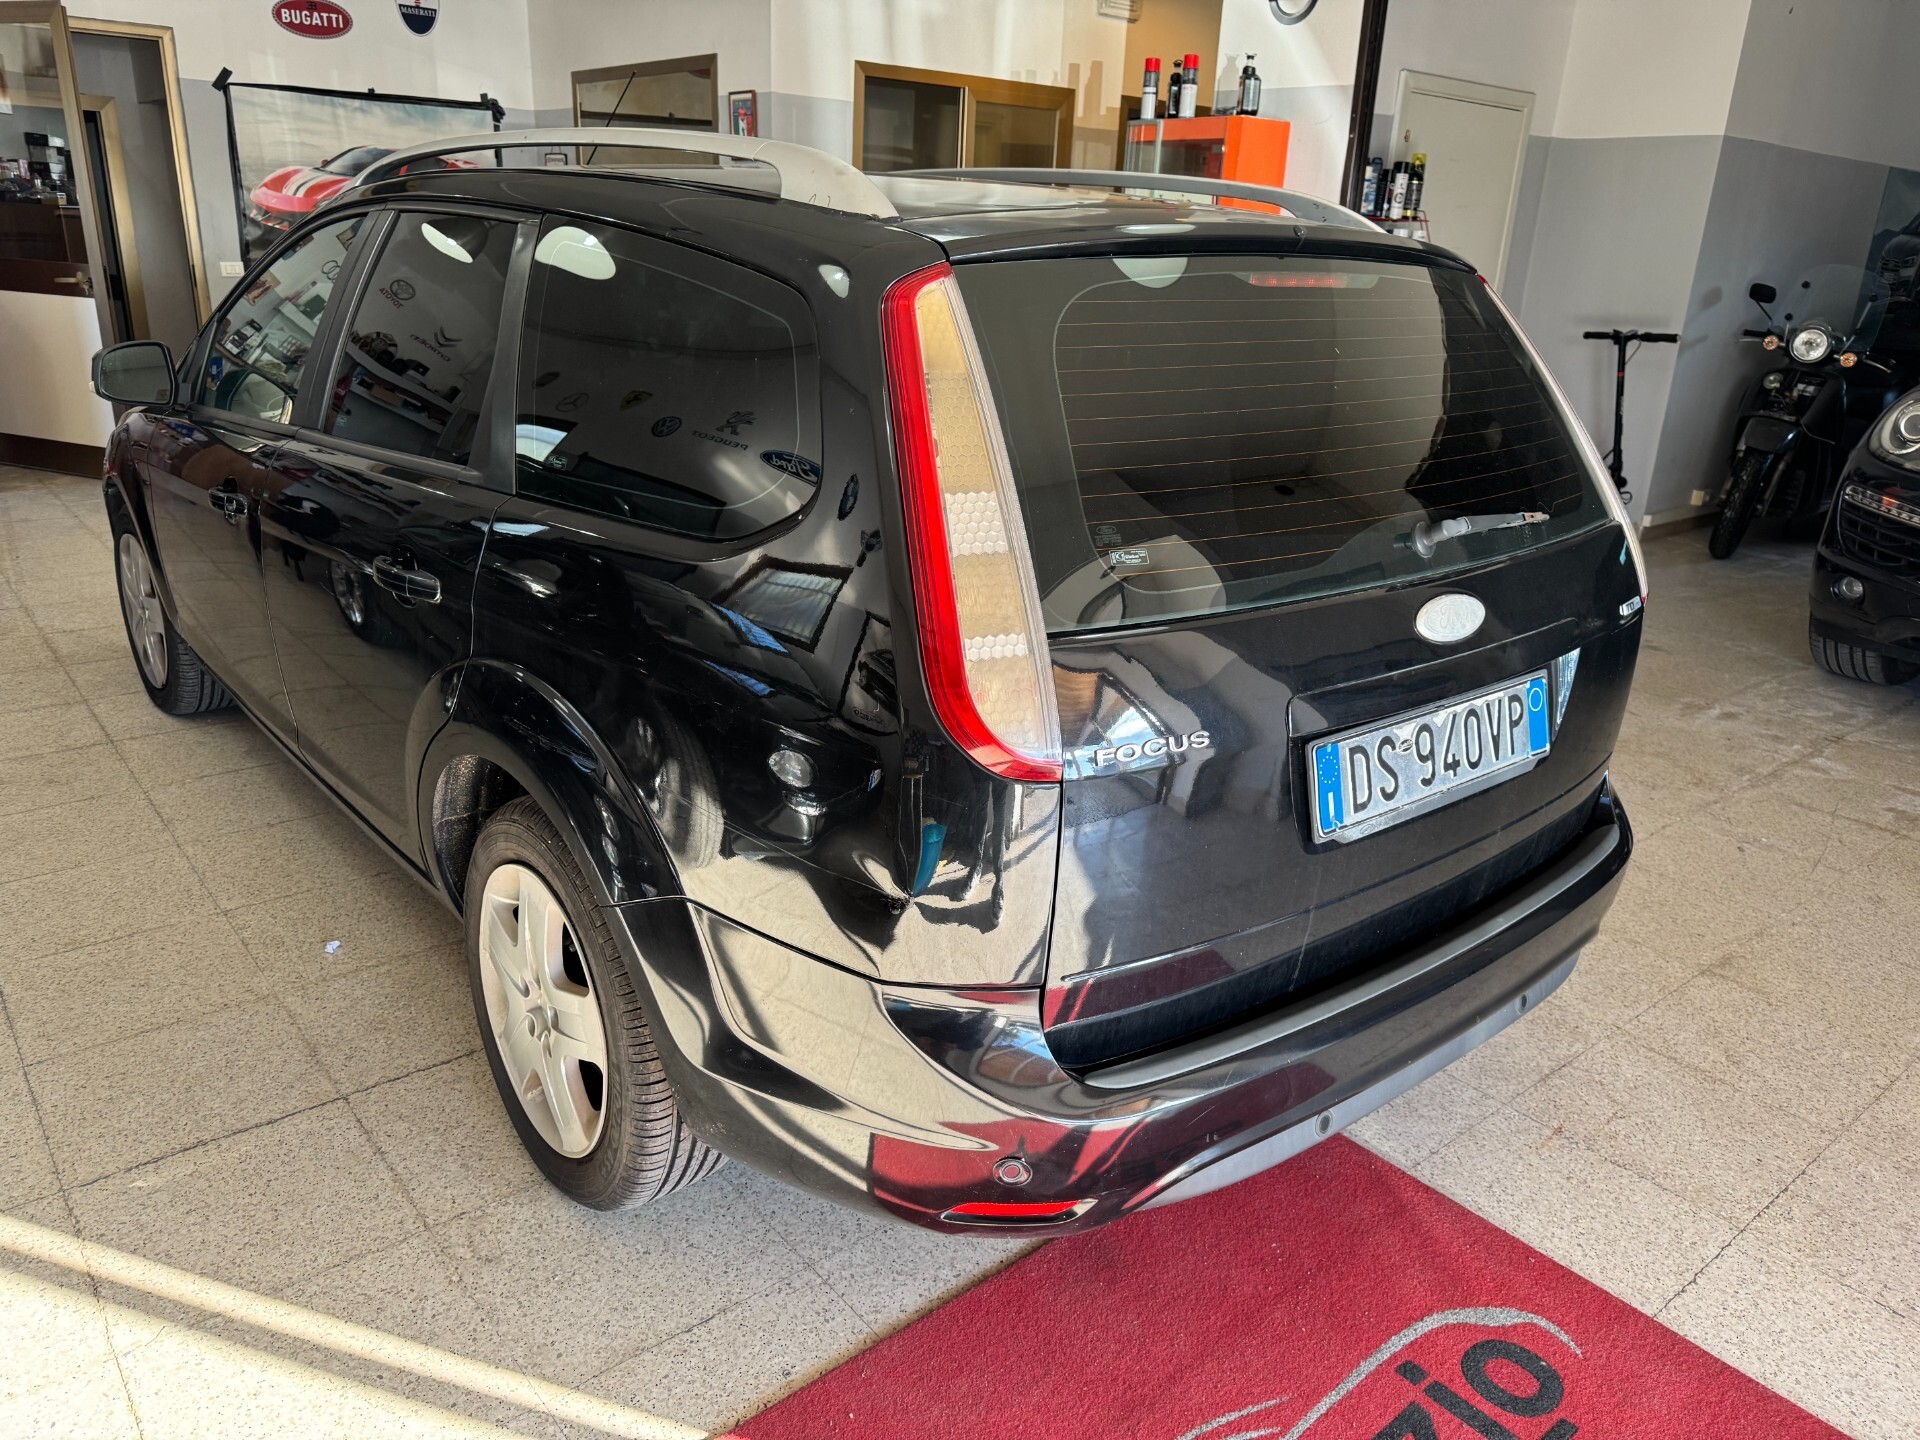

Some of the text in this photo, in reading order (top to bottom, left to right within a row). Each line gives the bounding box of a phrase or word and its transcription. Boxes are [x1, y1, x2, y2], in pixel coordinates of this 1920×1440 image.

[280, 8, 344, 29] BUGATTI
[400, 5, 436, 18] MASERATI
[1094, 730, 1211, 767] FOCUS
[1345, 735, 1400, 816] DS
[1412, 692, 1525, 788] 940VP
